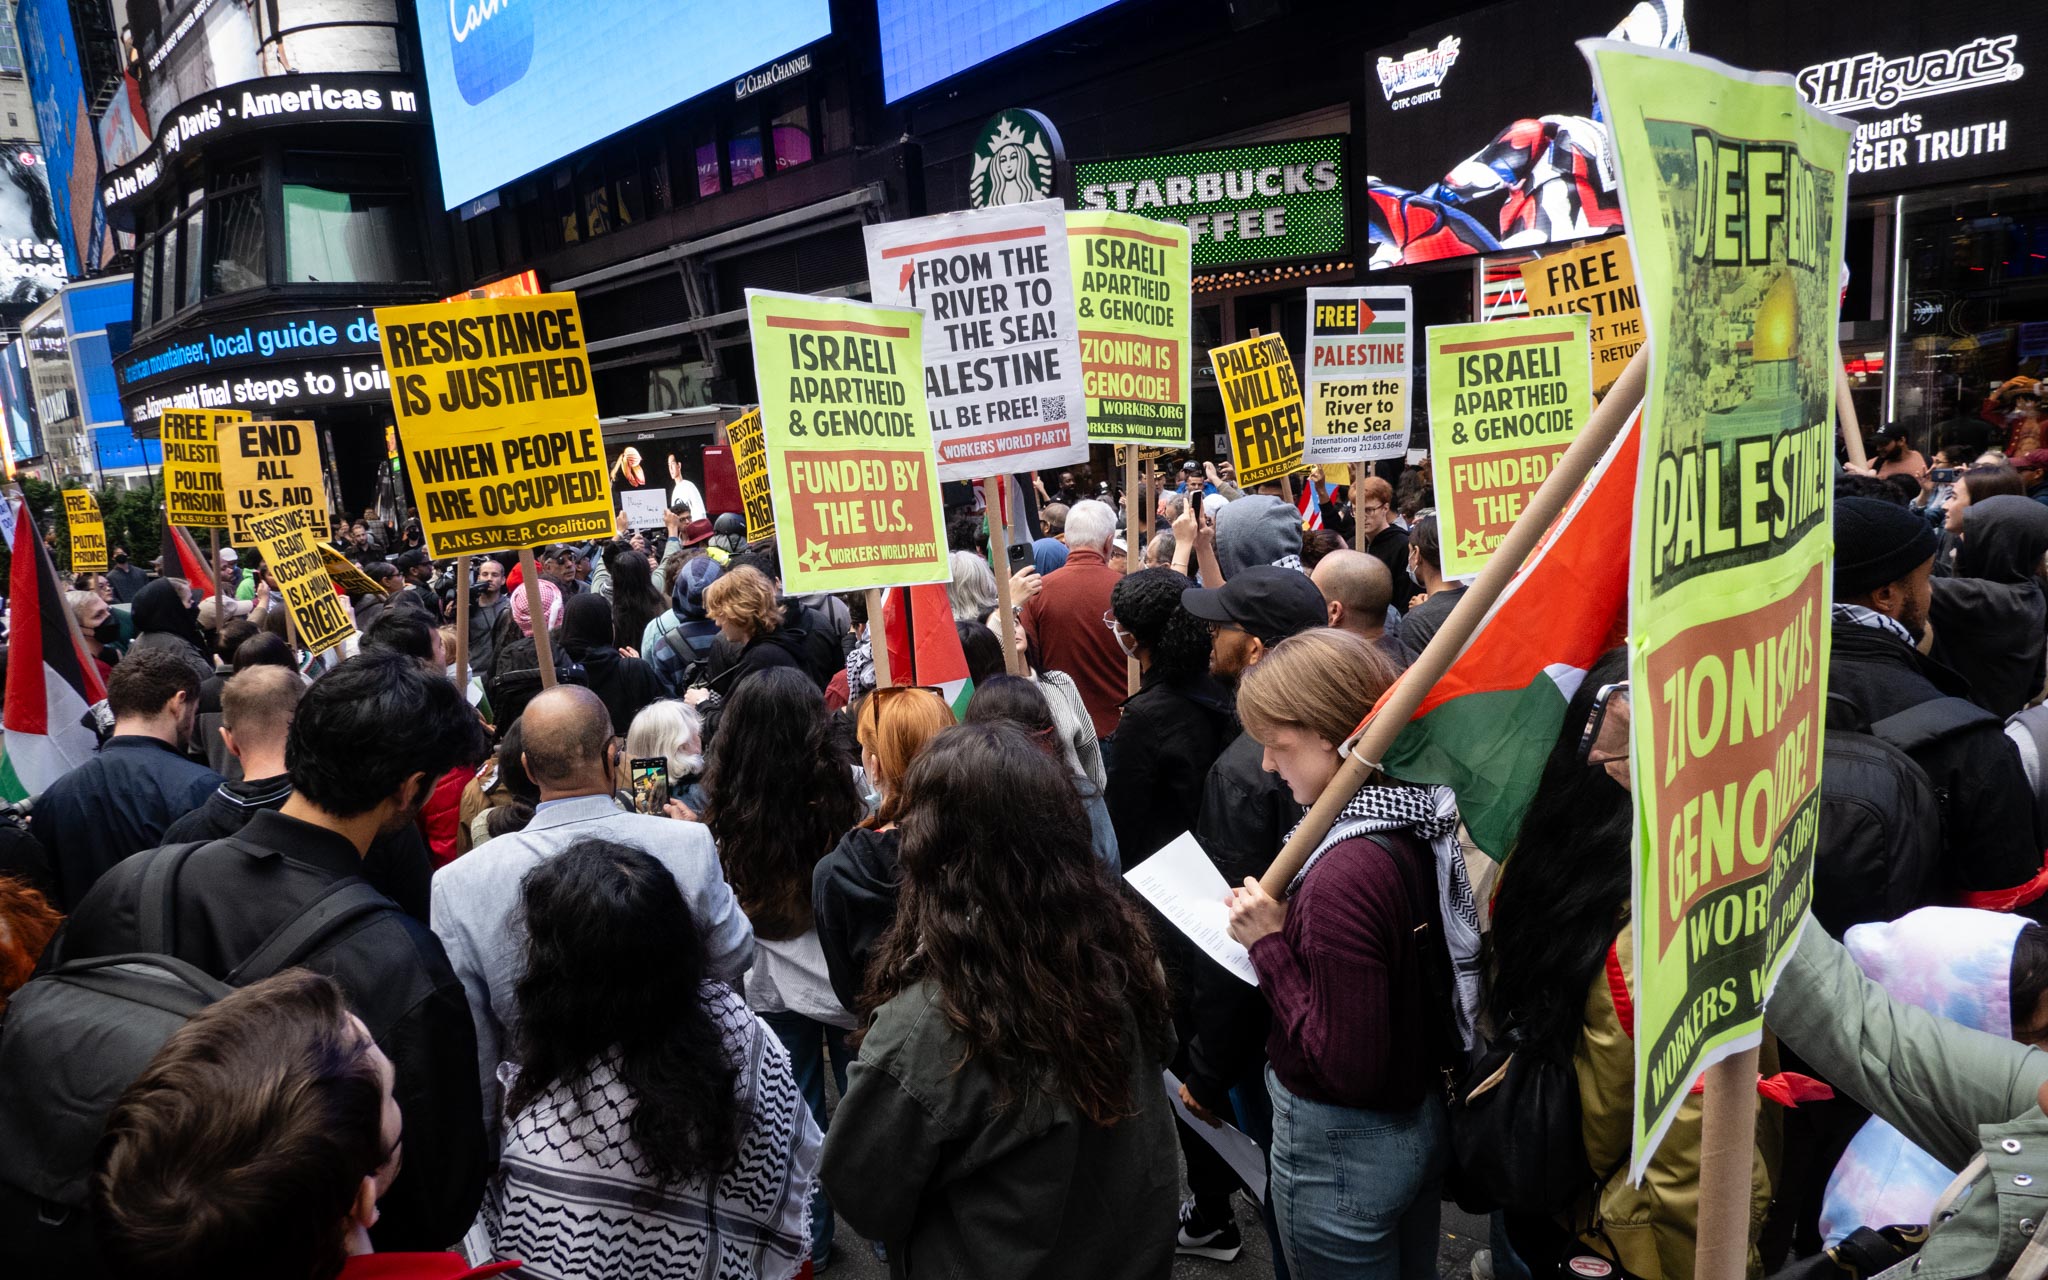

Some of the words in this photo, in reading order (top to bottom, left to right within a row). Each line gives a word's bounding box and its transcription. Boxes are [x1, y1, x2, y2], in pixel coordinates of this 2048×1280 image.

[242, 85, 382, 120] Americas
[1915, 120, 2007, 164] TRUTH
[1083, 160, 1338, 211] STARBUCKS
[1692, 130, 1817, 273] DEFEND
[9, 238, 64, 258] ife's
[1085, 238, 1165, 277] ISRAELI
[917, 252, 993, 289] FROM
[998, 244, 1049, 278] THE
[1547, 250, 1619, 297] FREE
[931, 283, 1008, 320] RIVER
[1014, 278, 1051, 308] TO
[1082, 271, 1170, 302] APARTHEID
[1079, 299, 1094, 318] &
[1099, 299, 1174, 328] GENOCIDE
[1316, 305, 1357, 328] FREE
[1611, 319, 1639, 337] THE
[210, 328, 253, 358] local
[257, 320, 338, 356] guide
[385, 308, 580, 368] RESISTANCE
[943, 319, 994, 351] THE
[999, 311, 1057, 345] SEA!
[789, 333, 897, 375] ISRAELI
[1081, 338, 1152, 368] ZIONISM
[1155, 346, 1171, 369] IS
[1216, 337, 1289, 379] PALESTINE
[1313, 343, 1404, 367] PALESTINE
[1458, 346, 1561, 388] ISRAELI
[199, 380, 232, 408] final
[234, 373, 299, 405] steps
[304, 371, 336, 395] to
[395, 373, 432, 417] IS
[439, 356, 587, 412] JUSTIFIED
[925, 348, 1061, 399] ALESTINE
[1084, 371, 1171, 401] GENOCIDE!
[1224, 371, 1279, 414] WILL
[1279, 363, 1297, 399] BE
[1320, 380, 1369, 398] From
[1372, 380, 1399, 395] the
[789, 376, 906, 406] APARTHEID
[1325, 401, 1373, 416] River
[1377, 399, 1394, 413] to
[1454, 381, 1568, 417] APARTHEID
[164, 413, 208, 440] FREE
[789, 409, 808, 437] &
[813, 409, 915, 437] GENOCIDE
[957, 403, 982, 428] BE
[987, 396, 1039, 424] FREE!
[1103, 401, 1184, 420] WORKERS.ORG
[1327, 419, 1358, 435] the
[1363, 417, 1391, 432] Sea
[1451, 422, 1469, 445] &
[1474, 409, 1573, 442] GENOCIDE
[238, 424, 302, 458] END
[944, 437, 995, 459] WORKERS
[996, 433, 1032, 452] WORLD
[1034, 428, 1067, 446] PARTY
[1126, 422, 1153, 437] WORLD
[1155, 425, 1183, 438] PARTY
[1217, 437, 1226, 449] A
[1234, 402, 1304, 470] FREE!
[1312, 435, 1359, 445] International
[1362, 434, 1381, 442] Action
[1382, 432, 1404, 441] Center
[413, 445, 499, 484] WHEN
[502, 429, 598, 474] PEOPLE
[1311, 444, 1357, 455] iacenter.org
[257, 460, 294, 480] ALL
[790, 459, 888, 494] FUNDED
[891, 461, 920, 492] BY
[1453, 453, 1547, 493] FUNDED
[239, 489, 278, 509] U.S.
[282, 487, 313, 506] AID
[428, 487, 476, 523] ARE
[480, 470, 605, 514] OCCUPIED!
[742, 483, 749, 500] IS
[749, 482, 755, 496] A
[1652, 421, 1828, 582] PALESTINE!
[813, 501, 867, 536] THE
[872, 499, 913, 533] U.S.
[1473, 496, 1521, 526] THE
[439, 528, 535, 550] A.N.S.W.E.R.
[537, 517, 606, 537] Coalition
[829, 545, 879, 564] WORKERS
[881, 543, 908, 562] WORLD
[908, 541, 937, 559] PARTY
[286, 586, 300, 607] IS
[300, 583, 309, 602] A
[1664, 613, 1799, 788] ZIONISM
[1652, 977, 1737, 1109] WORKERS
